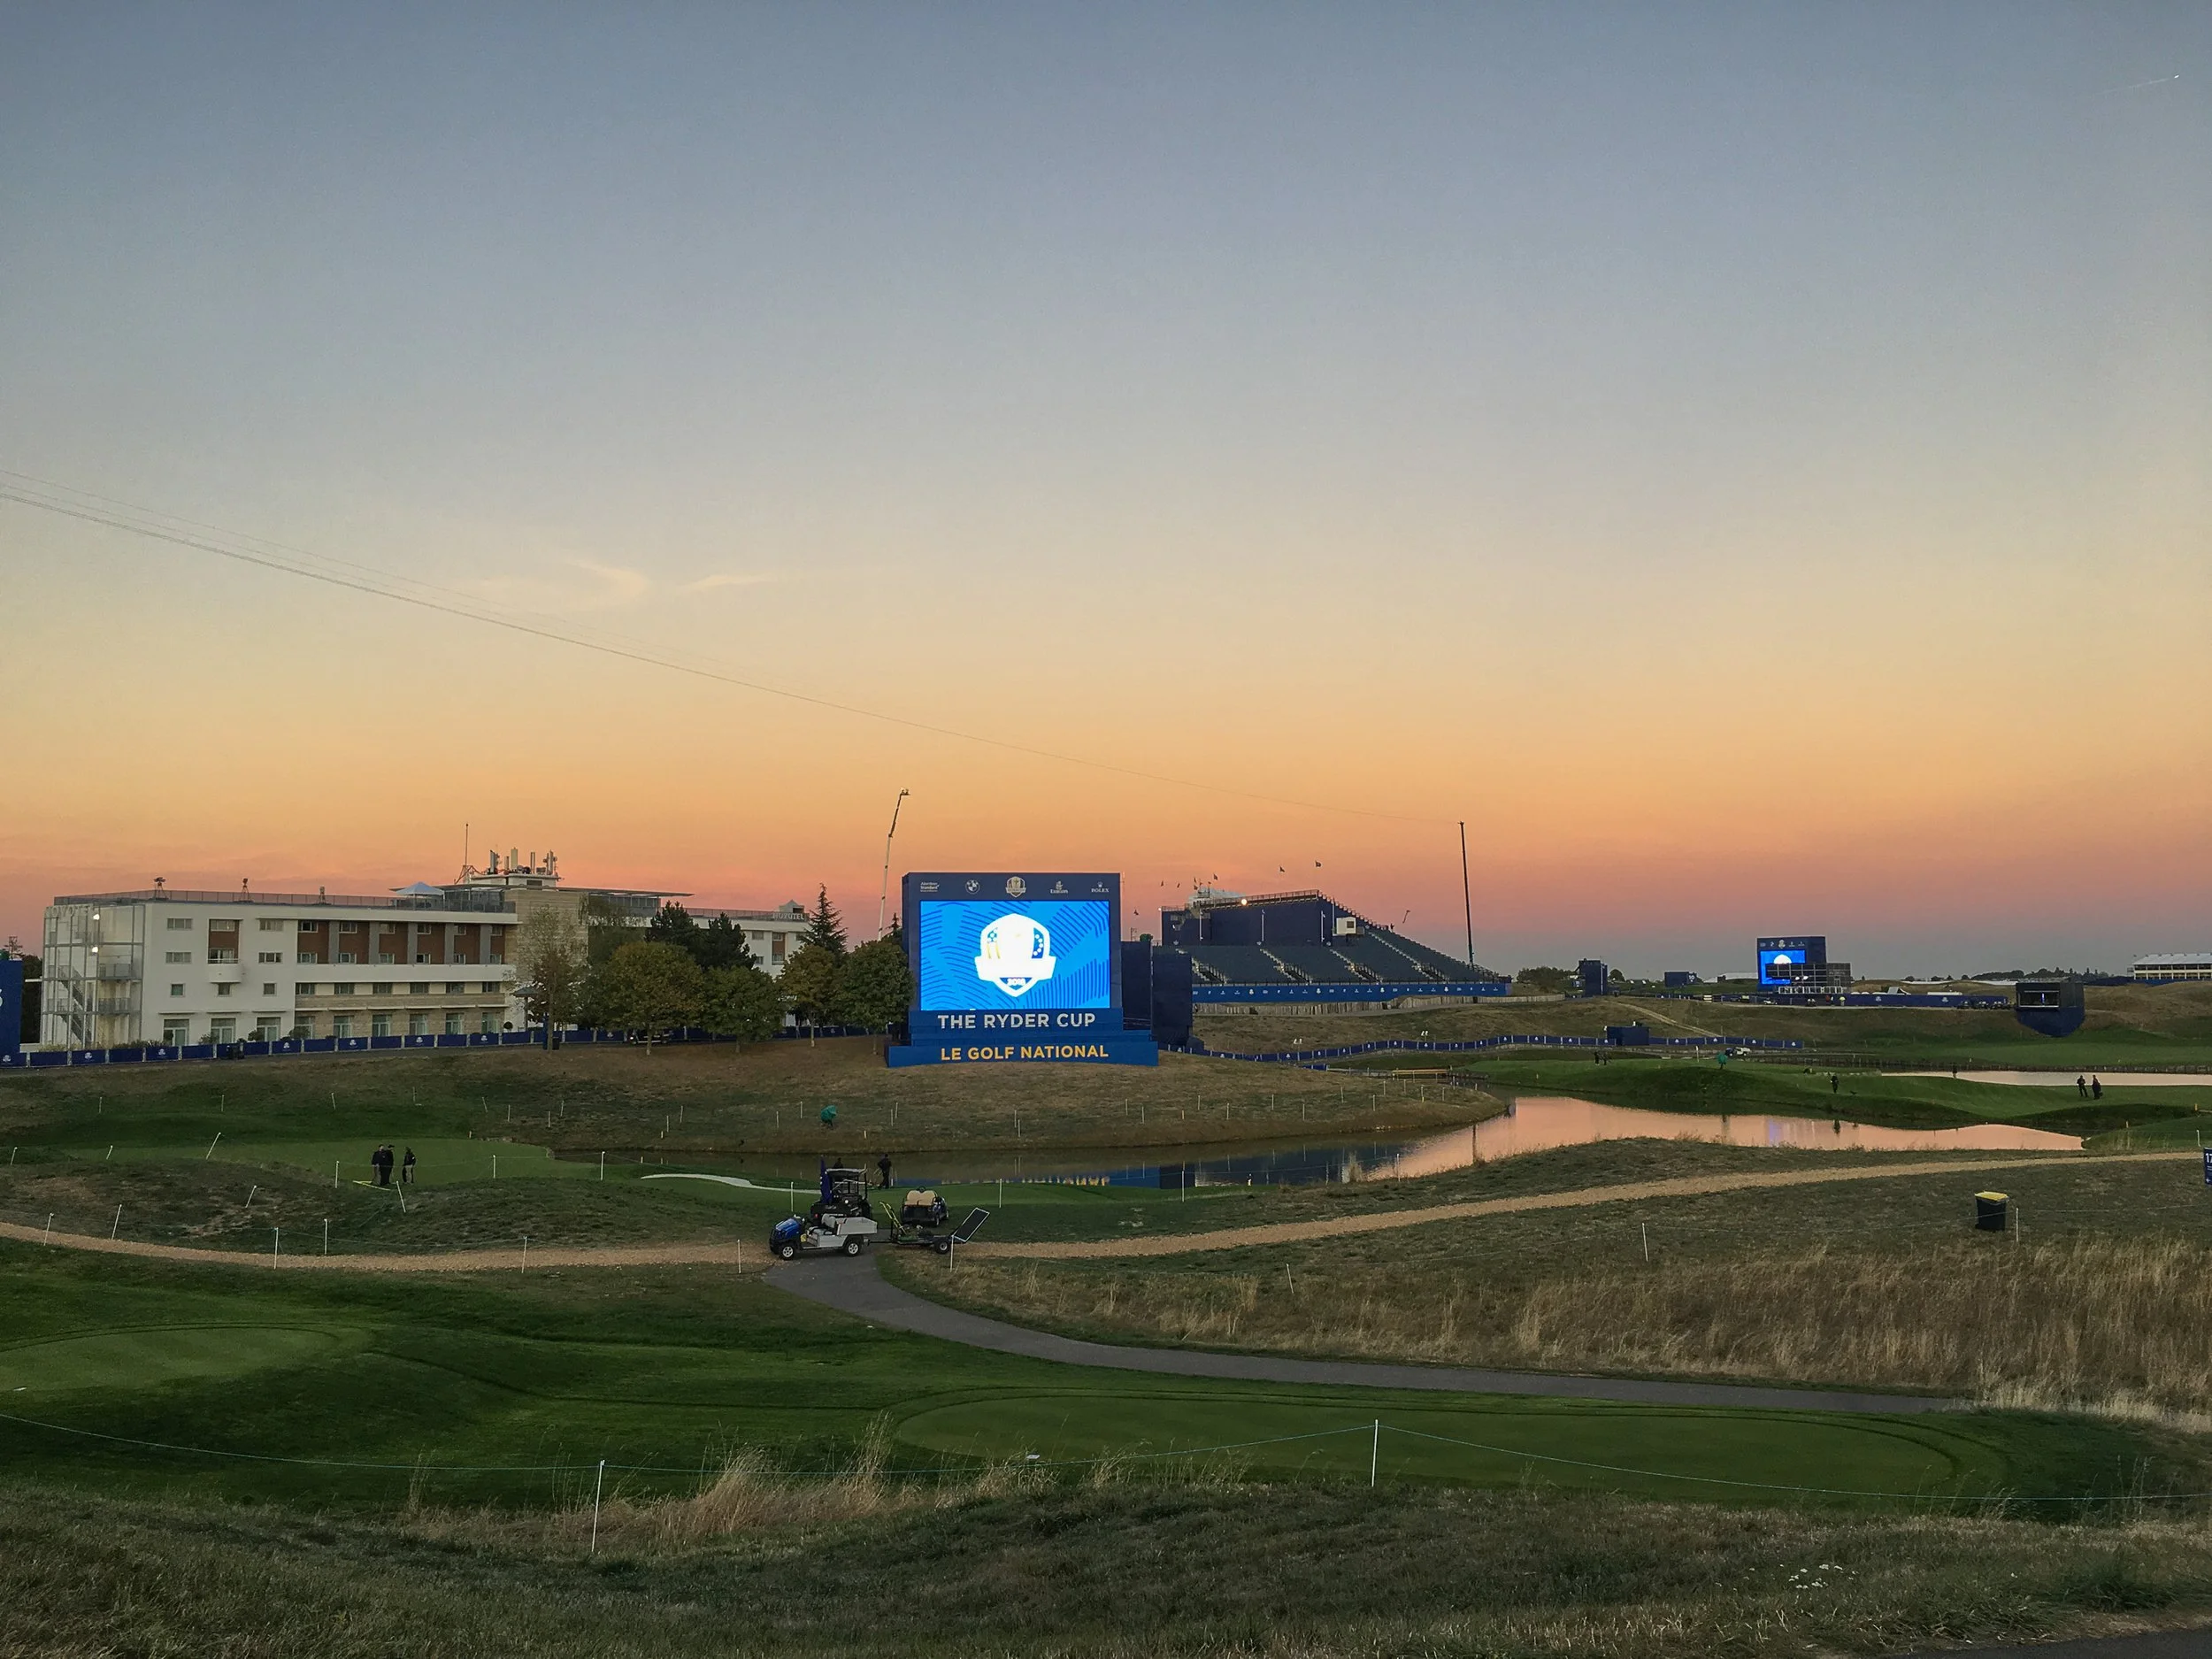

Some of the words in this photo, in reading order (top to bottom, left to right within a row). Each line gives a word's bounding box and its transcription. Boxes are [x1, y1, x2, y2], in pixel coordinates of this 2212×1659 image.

[938, 1014, 976, 1029] THE
[983, 1013, 1050, 1028] RYDER
[1056, 1012, 1096, 1027] CUP
[941, 1047, 962, 1061] LE
[967, 1046, 1015, 1060] GOLF
[1020, 1044, 1110, 1059] NATIONAL
